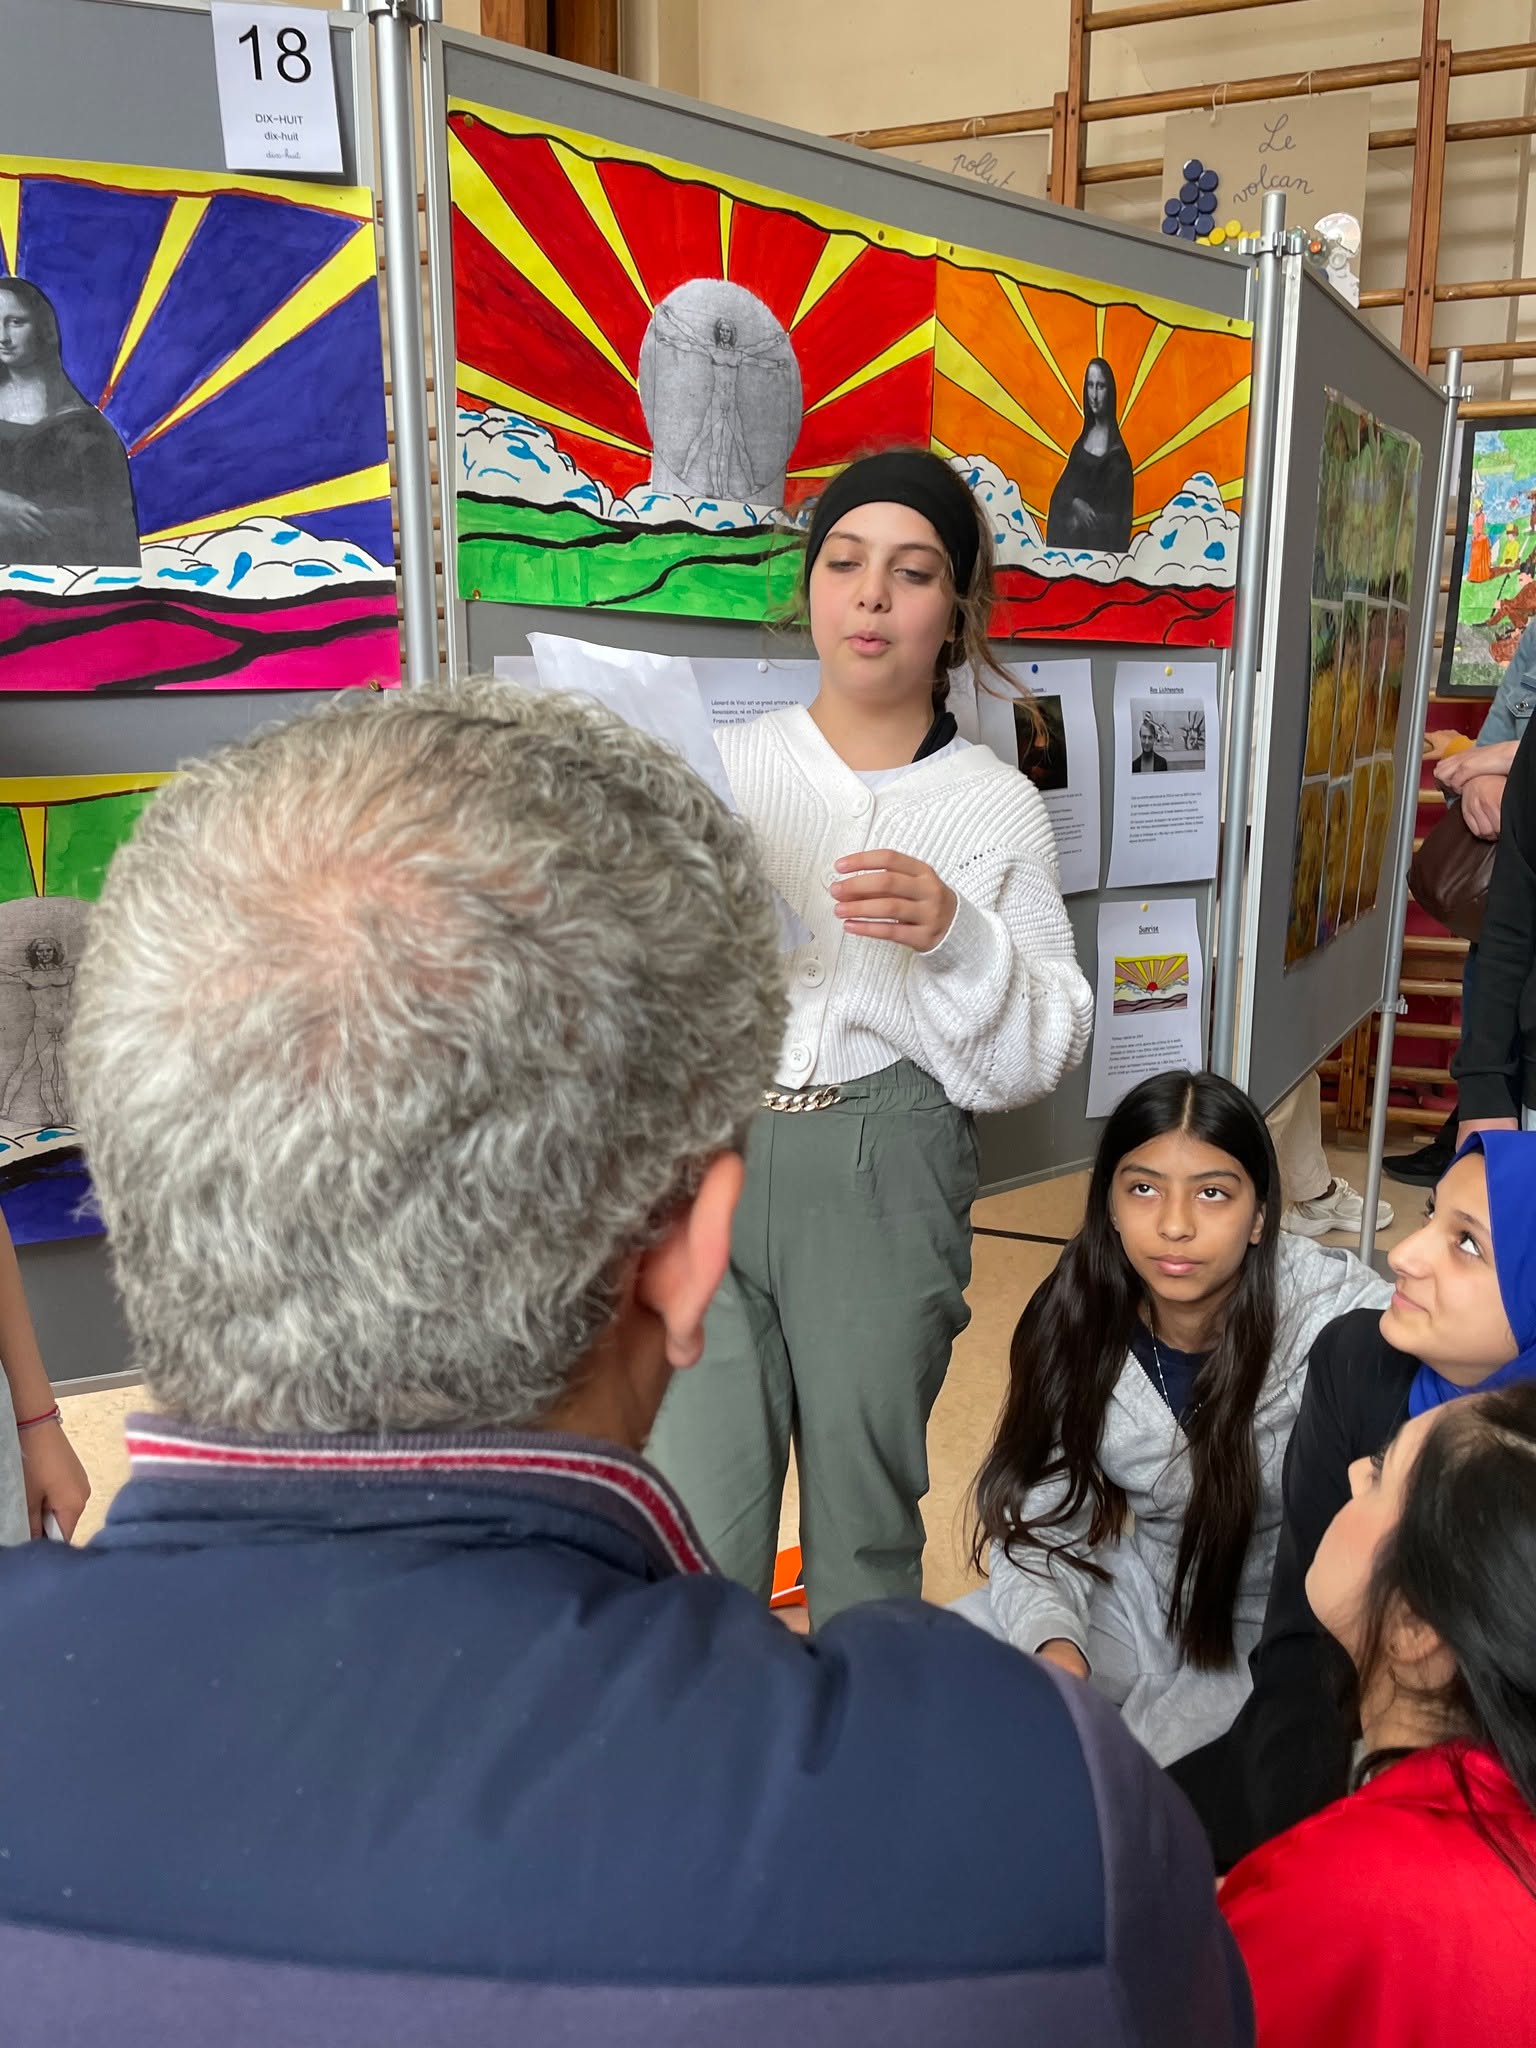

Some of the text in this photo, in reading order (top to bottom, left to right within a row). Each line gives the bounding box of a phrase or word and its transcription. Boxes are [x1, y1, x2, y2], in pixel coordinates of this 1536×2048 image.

[239, 25, 312, 83] 18
[255, 113, 304, 125] DIX-HUIT
[264, 132, 299, 141] dix-huit
[1259, 114, 1296, 153] Le
[1233, 164, 1314, 204] volcan
[1139, 925, 1159, 934] Sunrise
